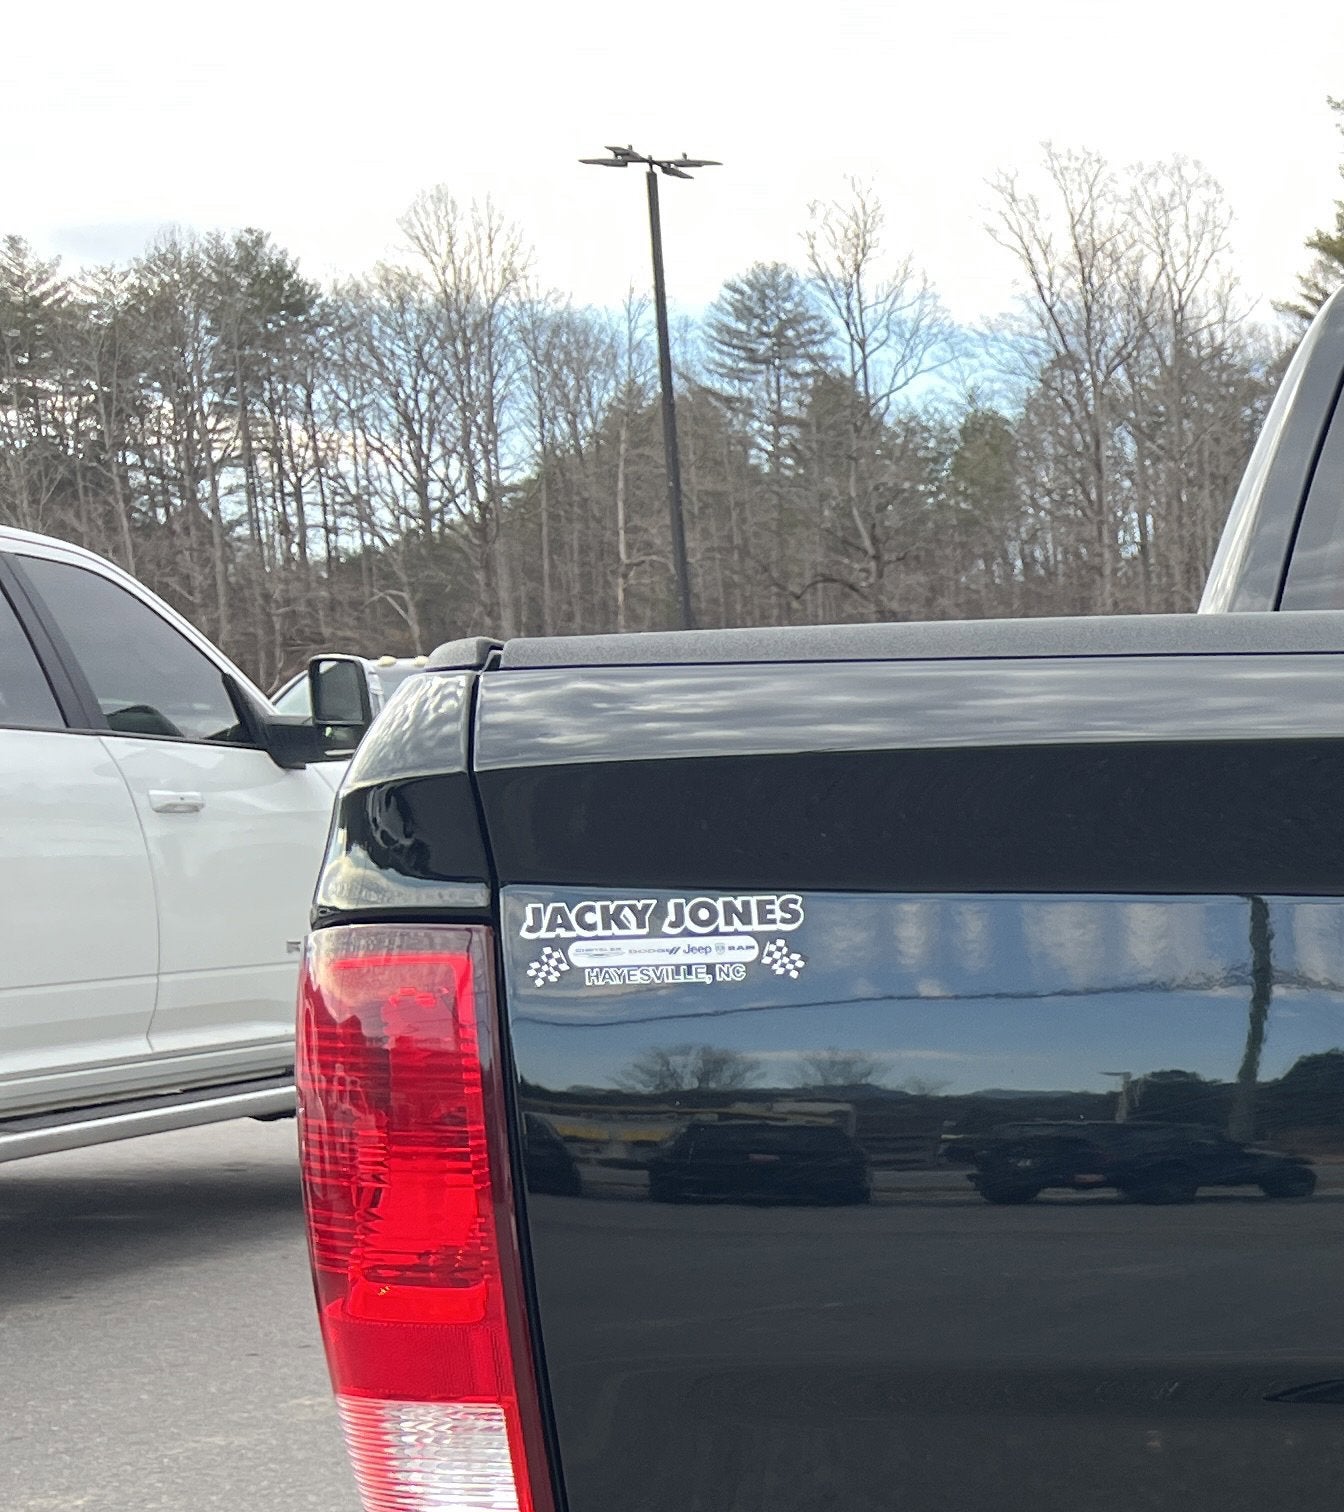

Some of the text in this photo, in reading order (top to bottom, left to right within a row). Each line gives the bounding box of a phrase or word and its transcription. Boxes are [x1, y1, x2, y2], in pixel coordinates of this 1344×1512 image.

[519, 894, 804, 939] JACKY JONES
[683, 943, 712, 954] Jeep
[585, 963, 746, 985] HAYESVILLE, NC
